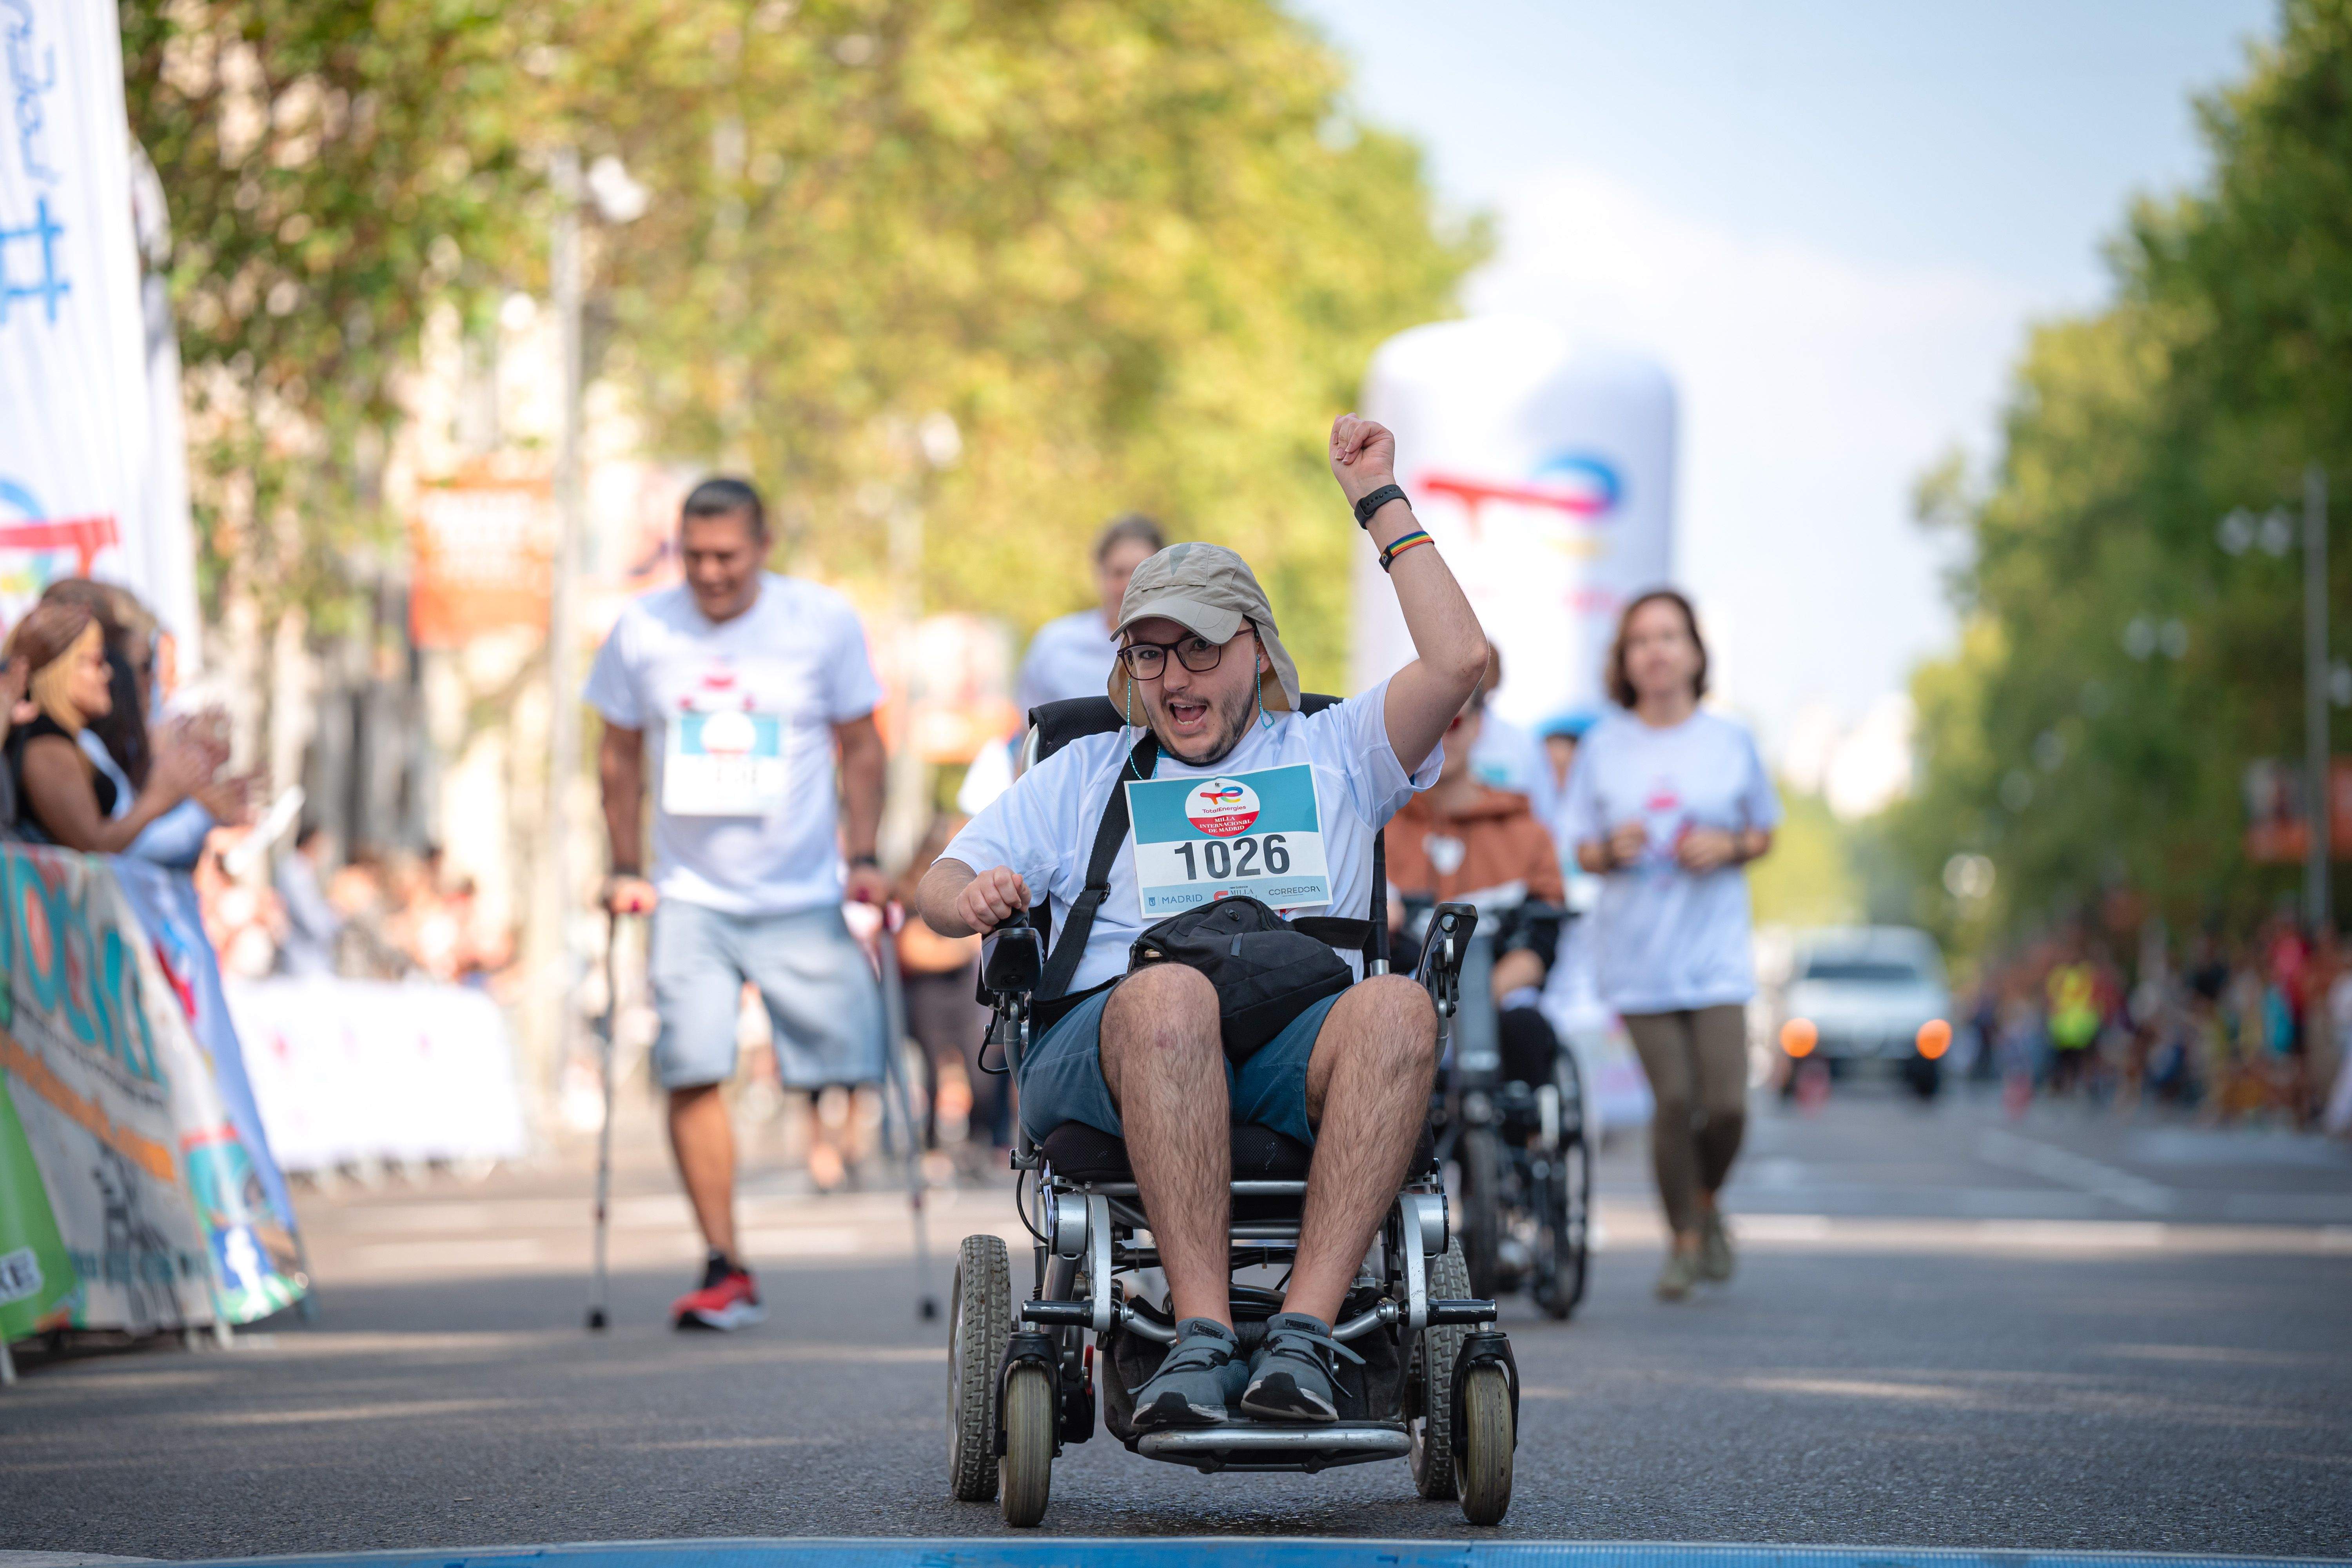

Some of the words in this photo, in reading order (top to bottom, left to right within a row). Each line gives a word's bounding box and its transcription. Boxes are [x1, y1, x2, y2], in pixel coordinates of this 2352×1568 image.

[1202, 805, 1246, 814] TotalEnergies
[1174, 834, 1290, 880] 1026
[1162, 894, 1203, 904] MADRID
